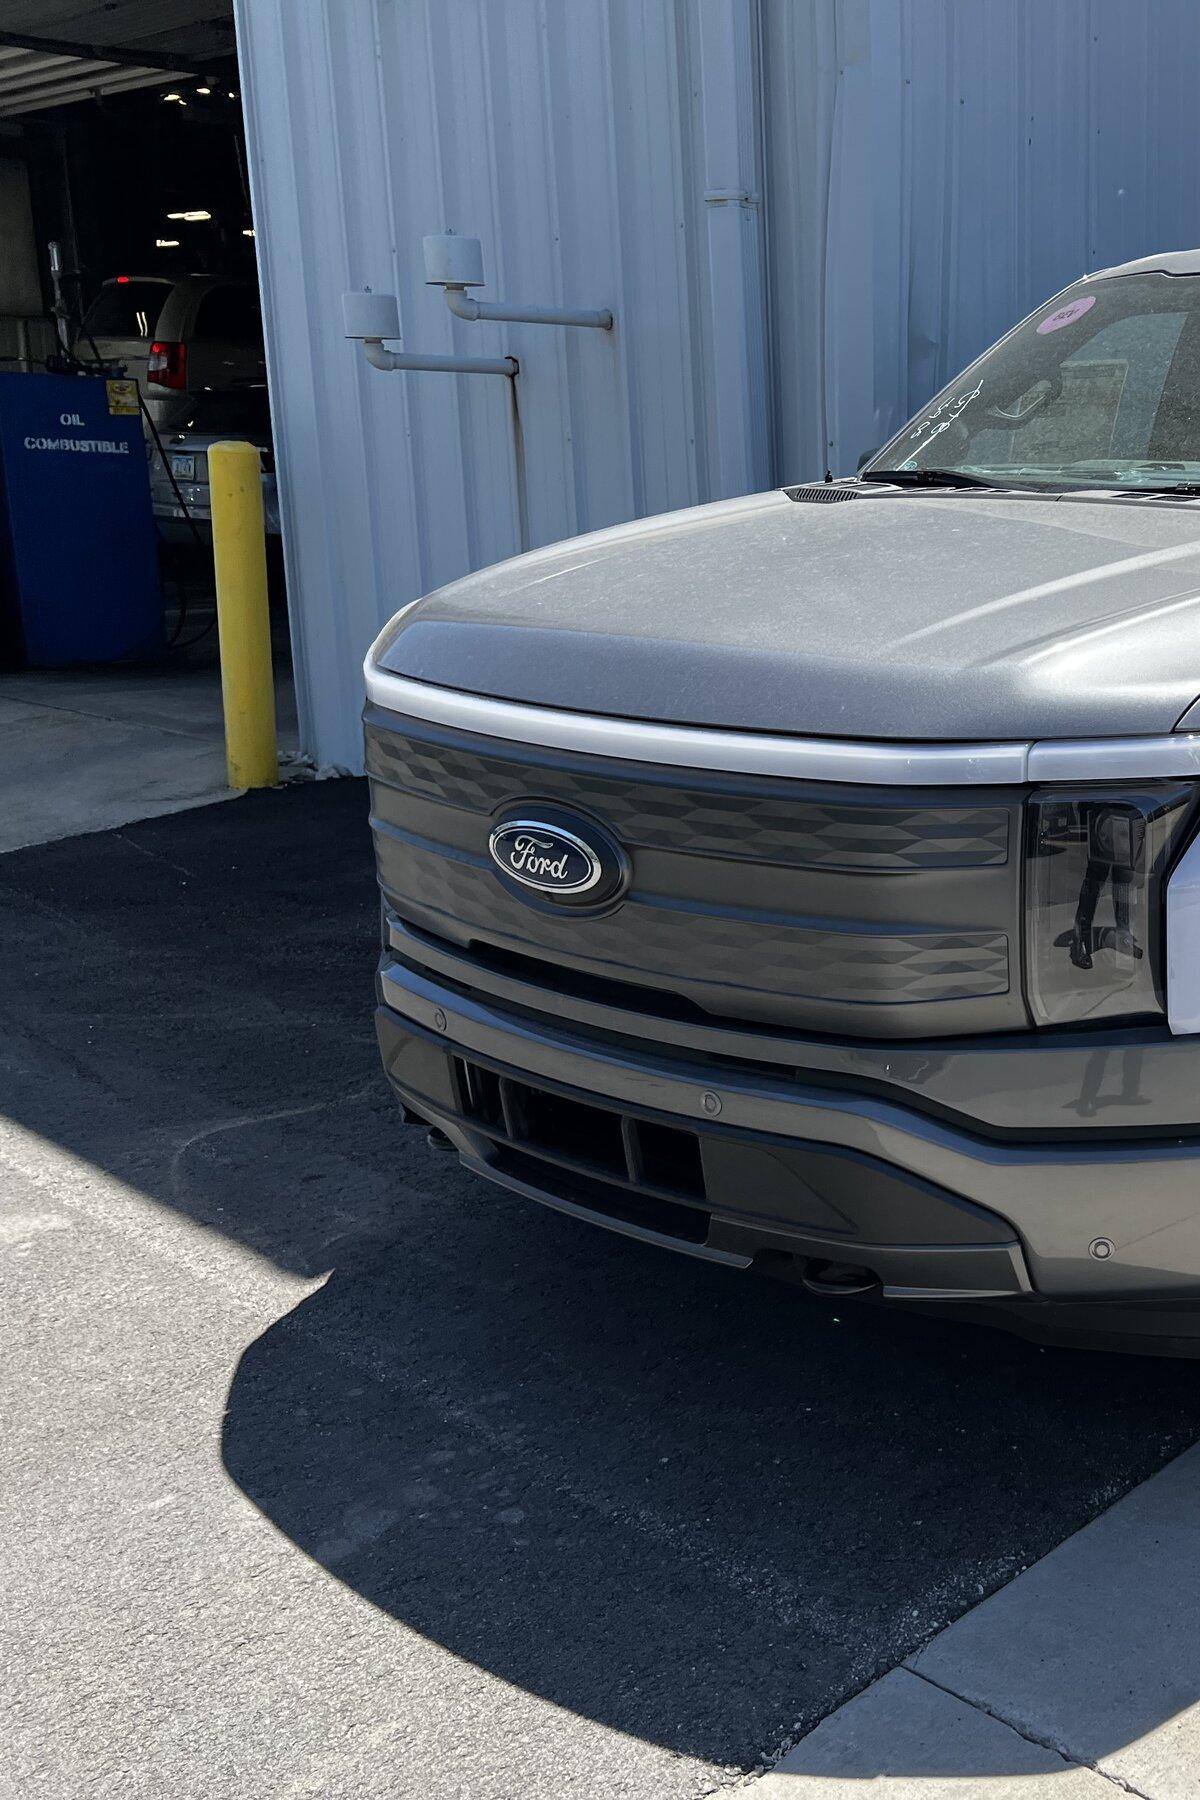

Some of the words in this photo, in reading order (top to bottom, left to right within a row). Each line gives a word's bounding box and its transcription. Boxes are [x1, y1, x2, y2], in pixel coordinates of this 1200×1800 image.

[60, 413, 86, 427] OIL
[23, 436, 130, 454] COMBUSTIBLE
[510, 834, 569, 879] Ford
